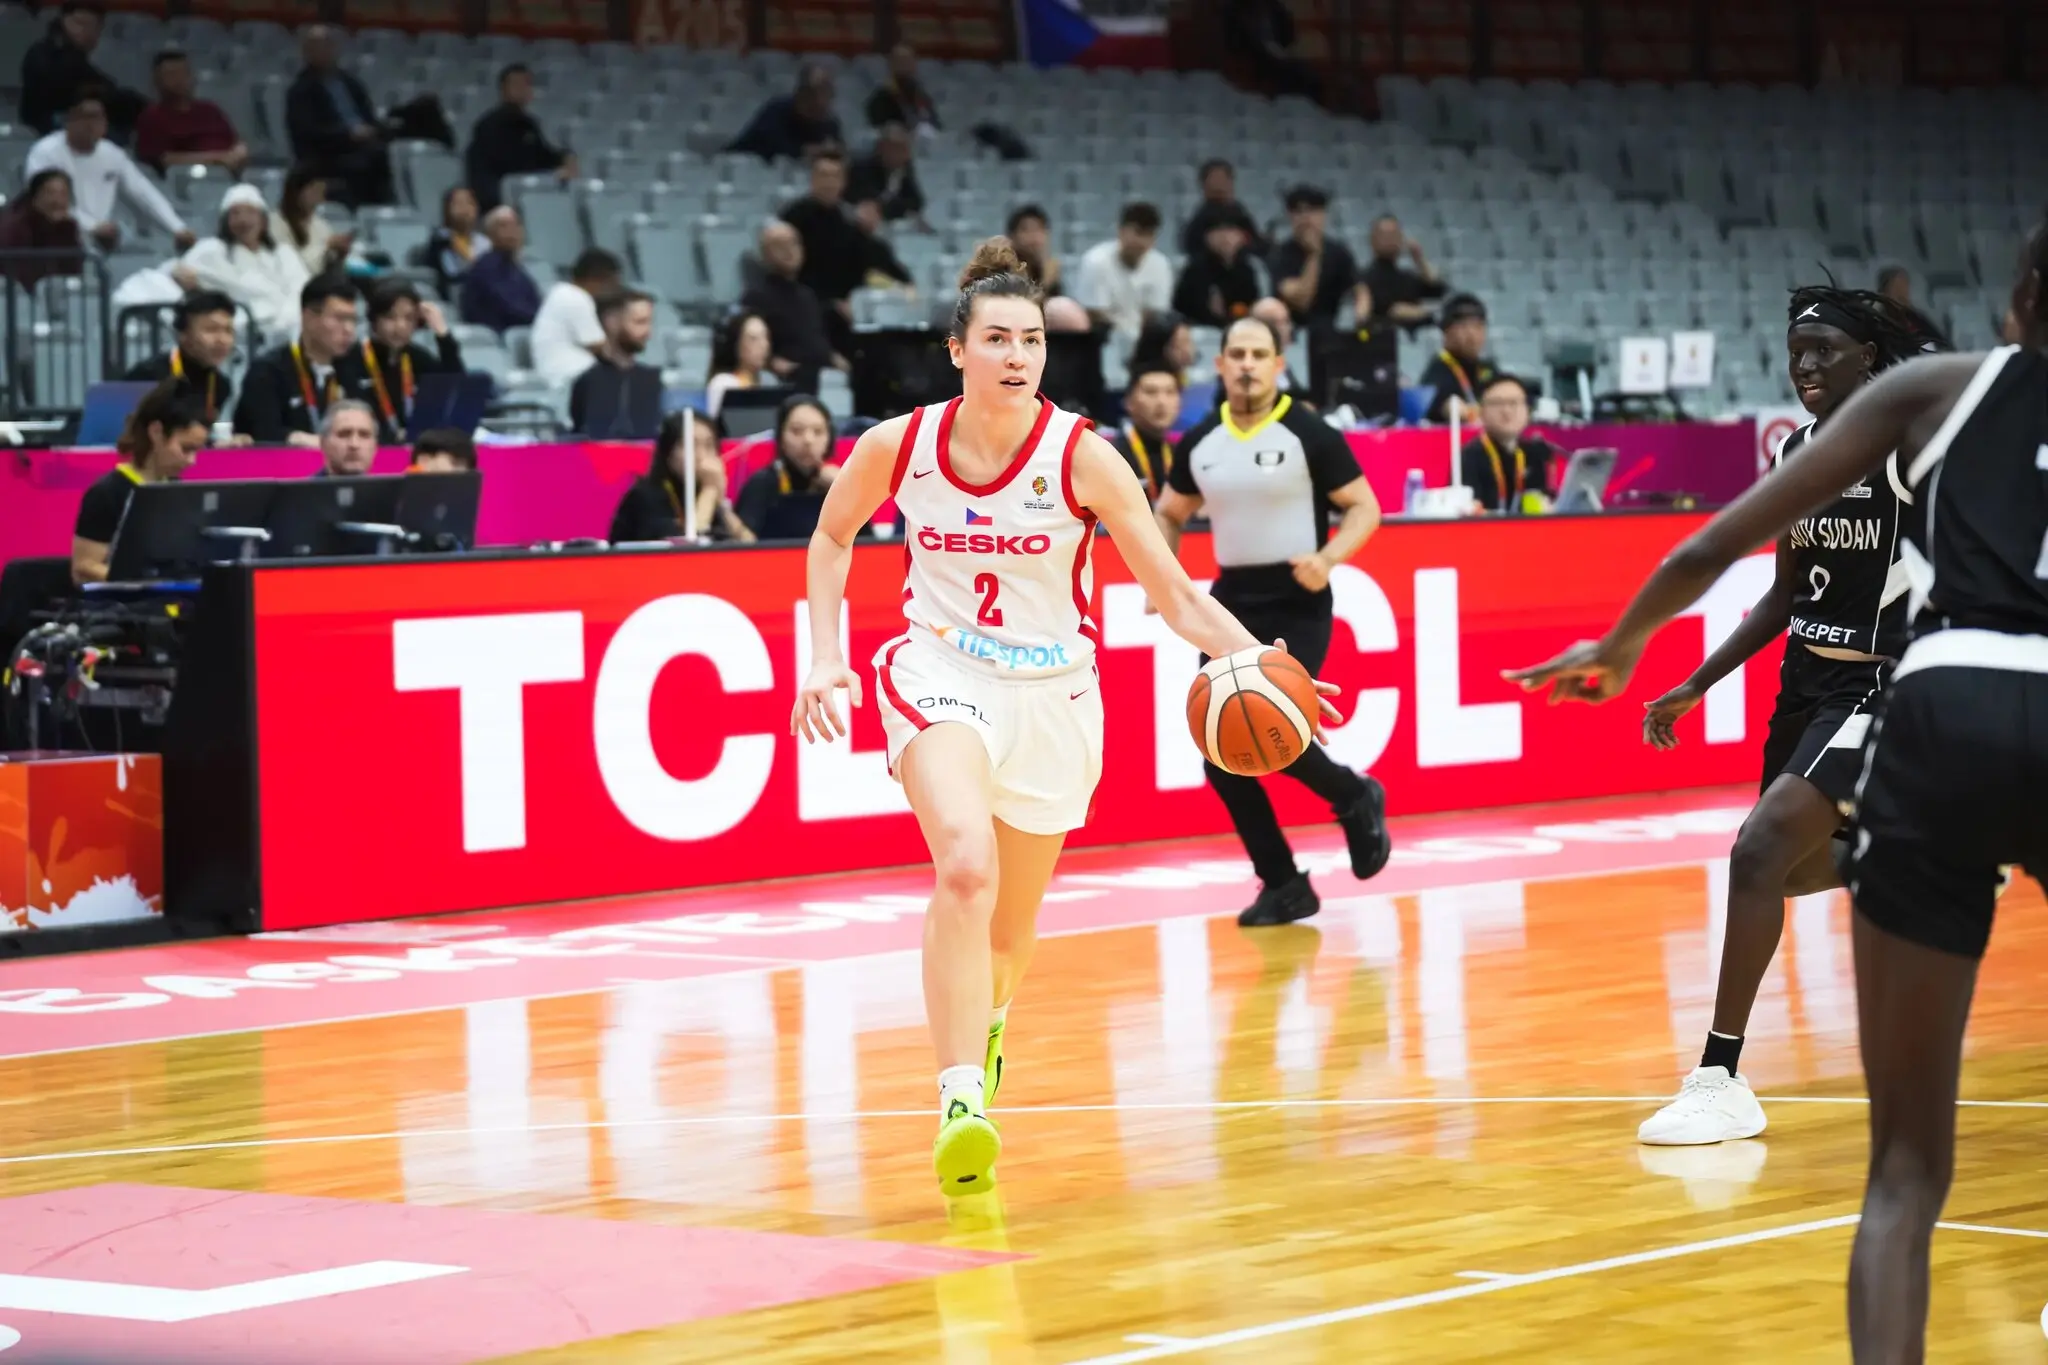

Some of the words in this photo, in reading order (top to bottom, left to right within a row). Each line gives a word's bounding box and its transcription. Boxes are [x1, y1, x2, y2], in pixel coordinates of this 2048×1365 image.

[917, 526, 1051, 555] ČESKO
[1818, 517, 1880, 551] SUDAN
[974, 572, 1003, 627] 2
[957, 629, 1069, 669] Tipsport
[392, 592, 915, 853] TCL
